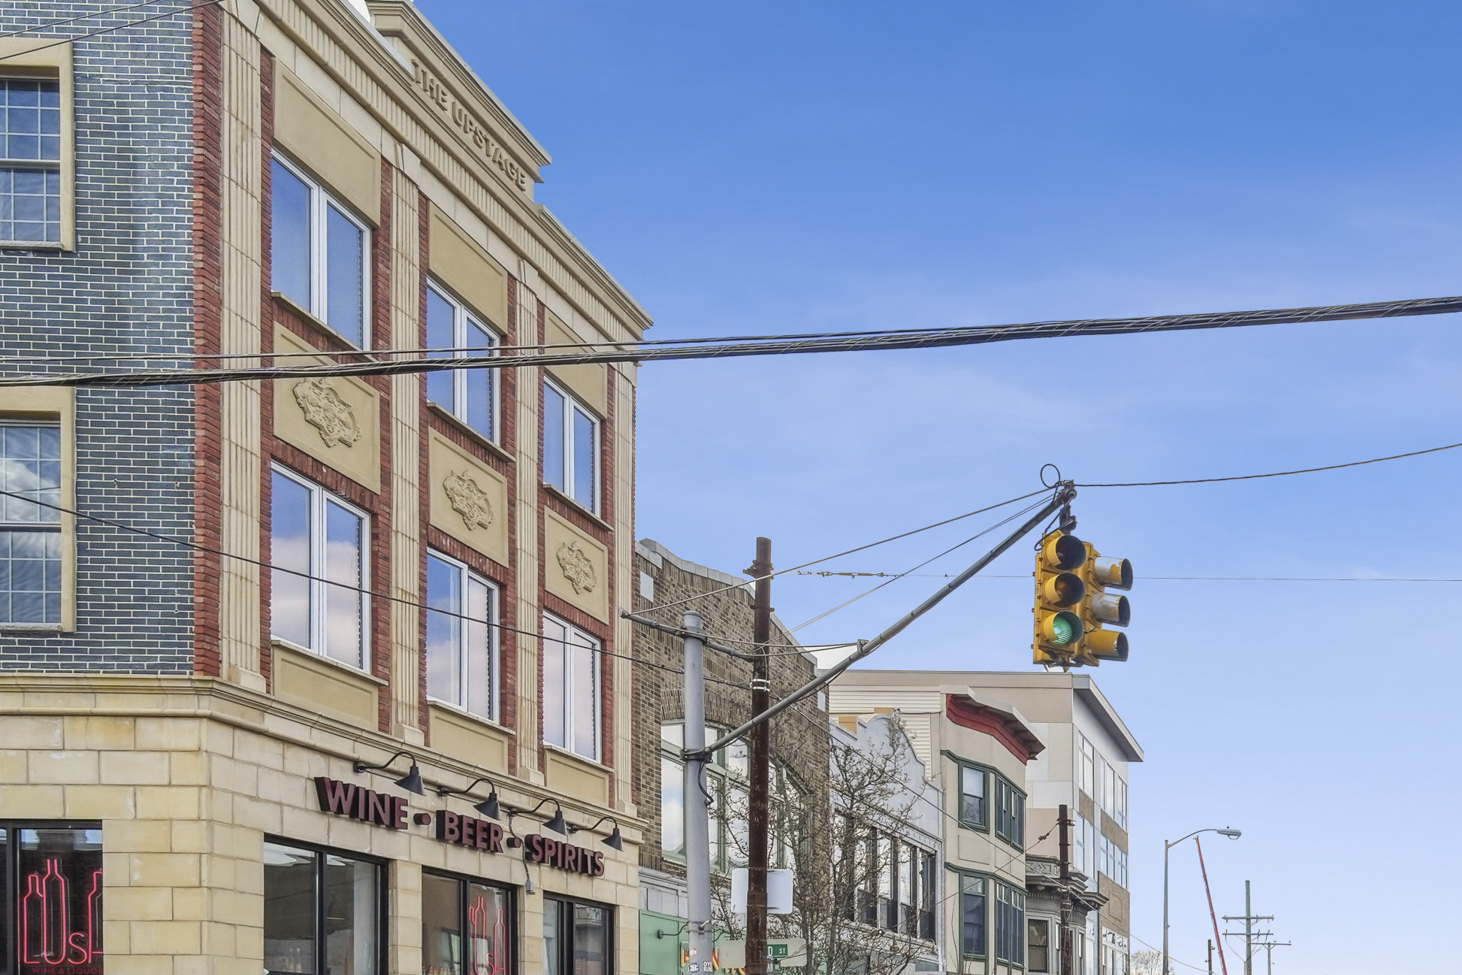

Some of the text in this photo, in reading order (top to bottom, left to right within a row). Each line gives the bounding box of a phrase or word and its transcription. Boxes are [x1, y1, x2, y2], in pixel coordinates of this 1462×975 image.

[411, 58, 527, 192] THE UPSTAGE
[314, 777, 605, 877] WINE BEER SPIRITS
